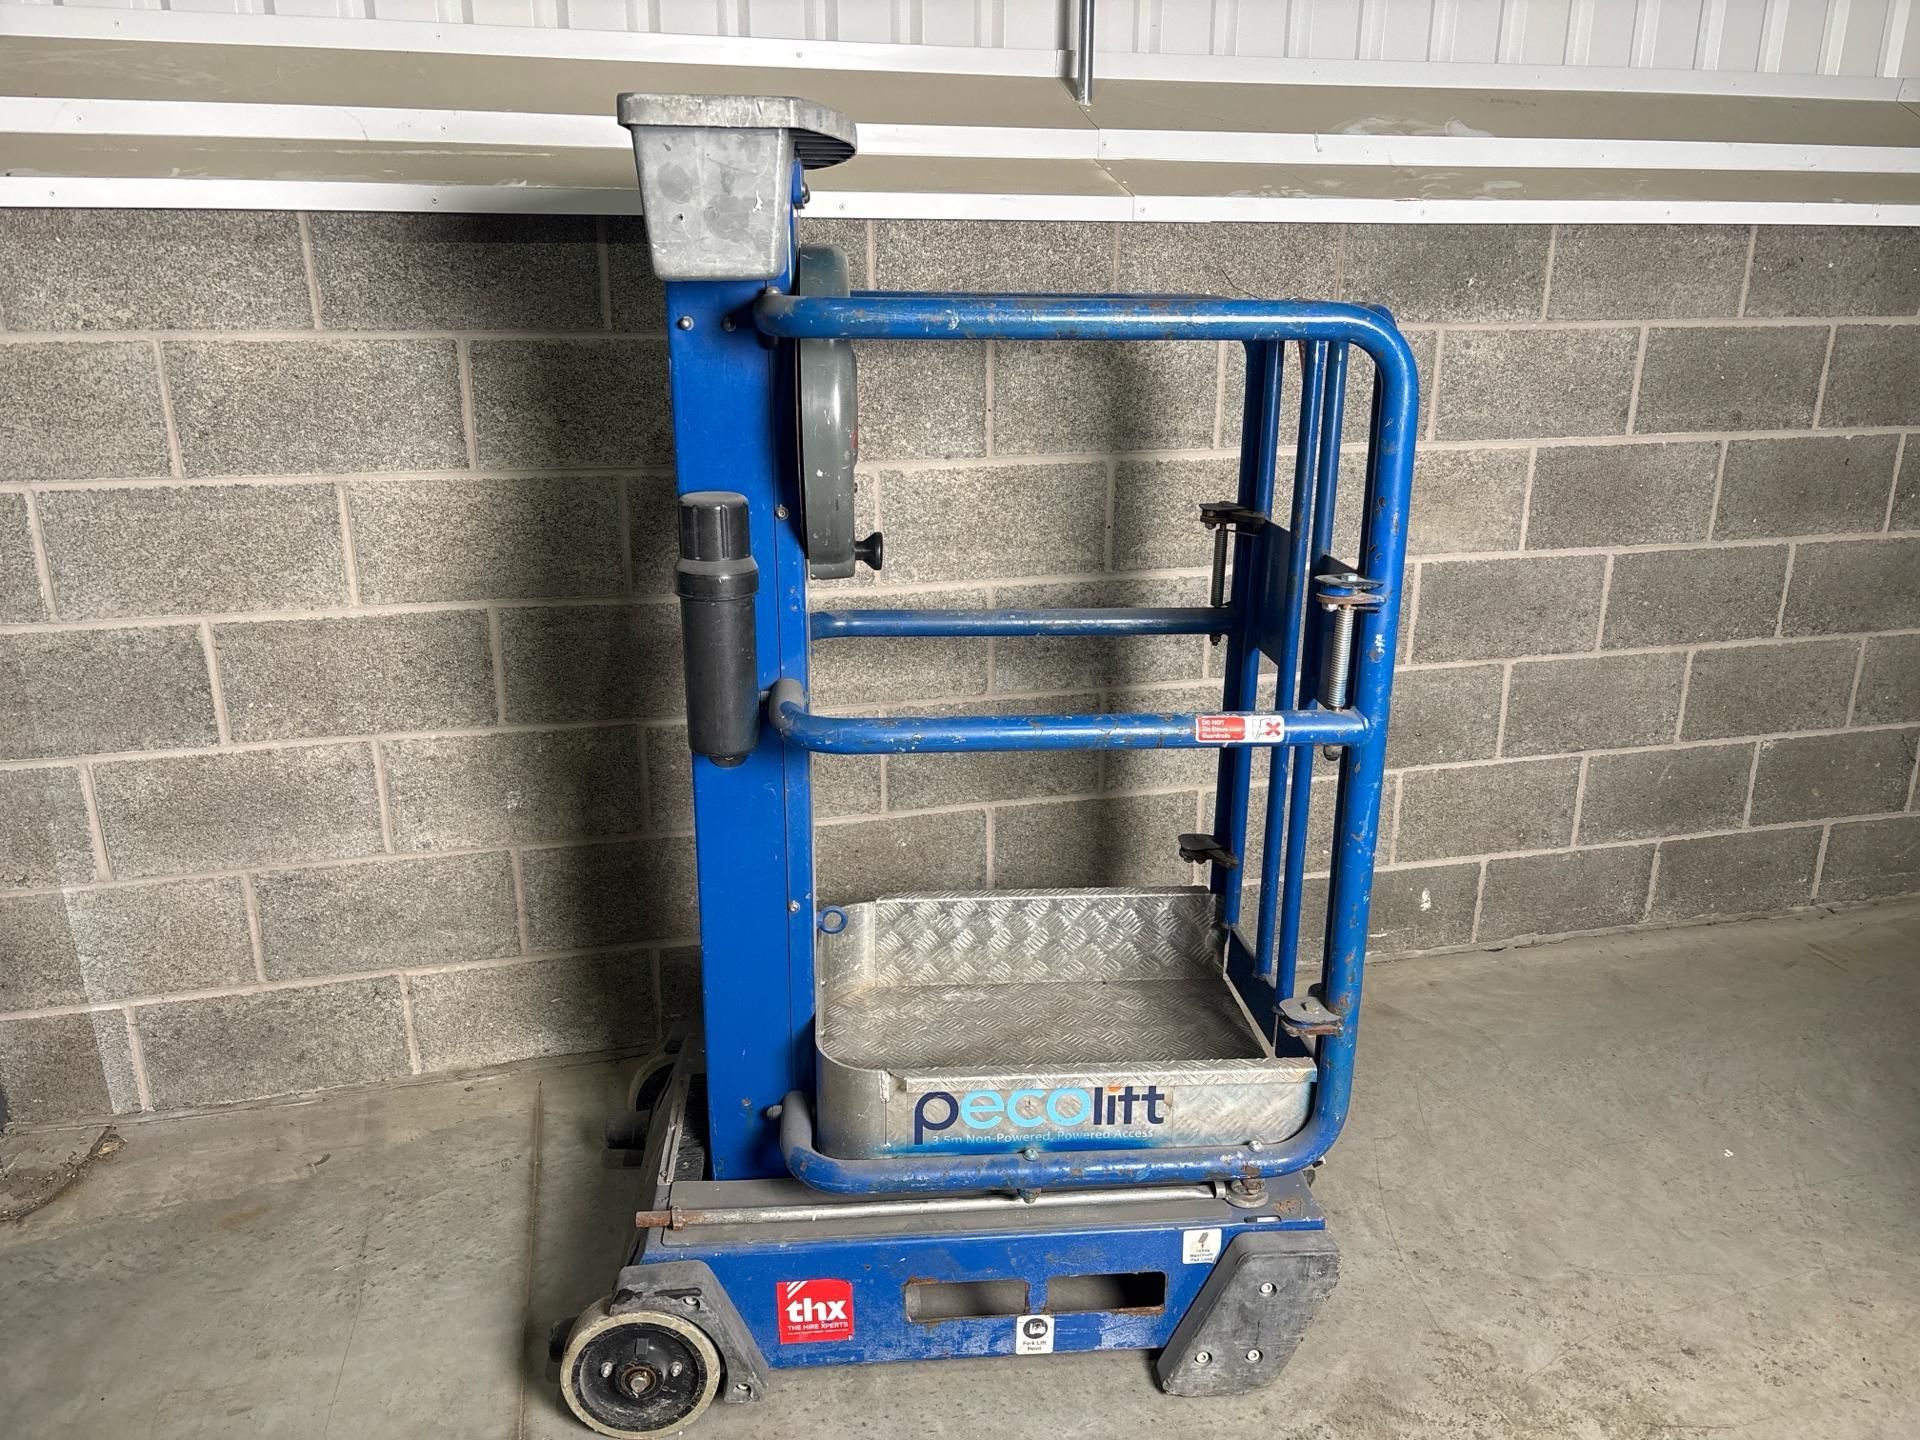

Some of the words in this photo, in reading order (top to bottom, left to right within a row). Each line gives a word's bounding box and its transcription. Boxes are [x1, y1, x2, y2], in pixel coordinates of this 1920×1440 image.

[914, 1085, 1165, 1145] pecolift
[1057, 1129, 1110, 1141] Powered
[1115, 1129, 1153, 1139] Access
[785, 1297, 848, 1323] thx
